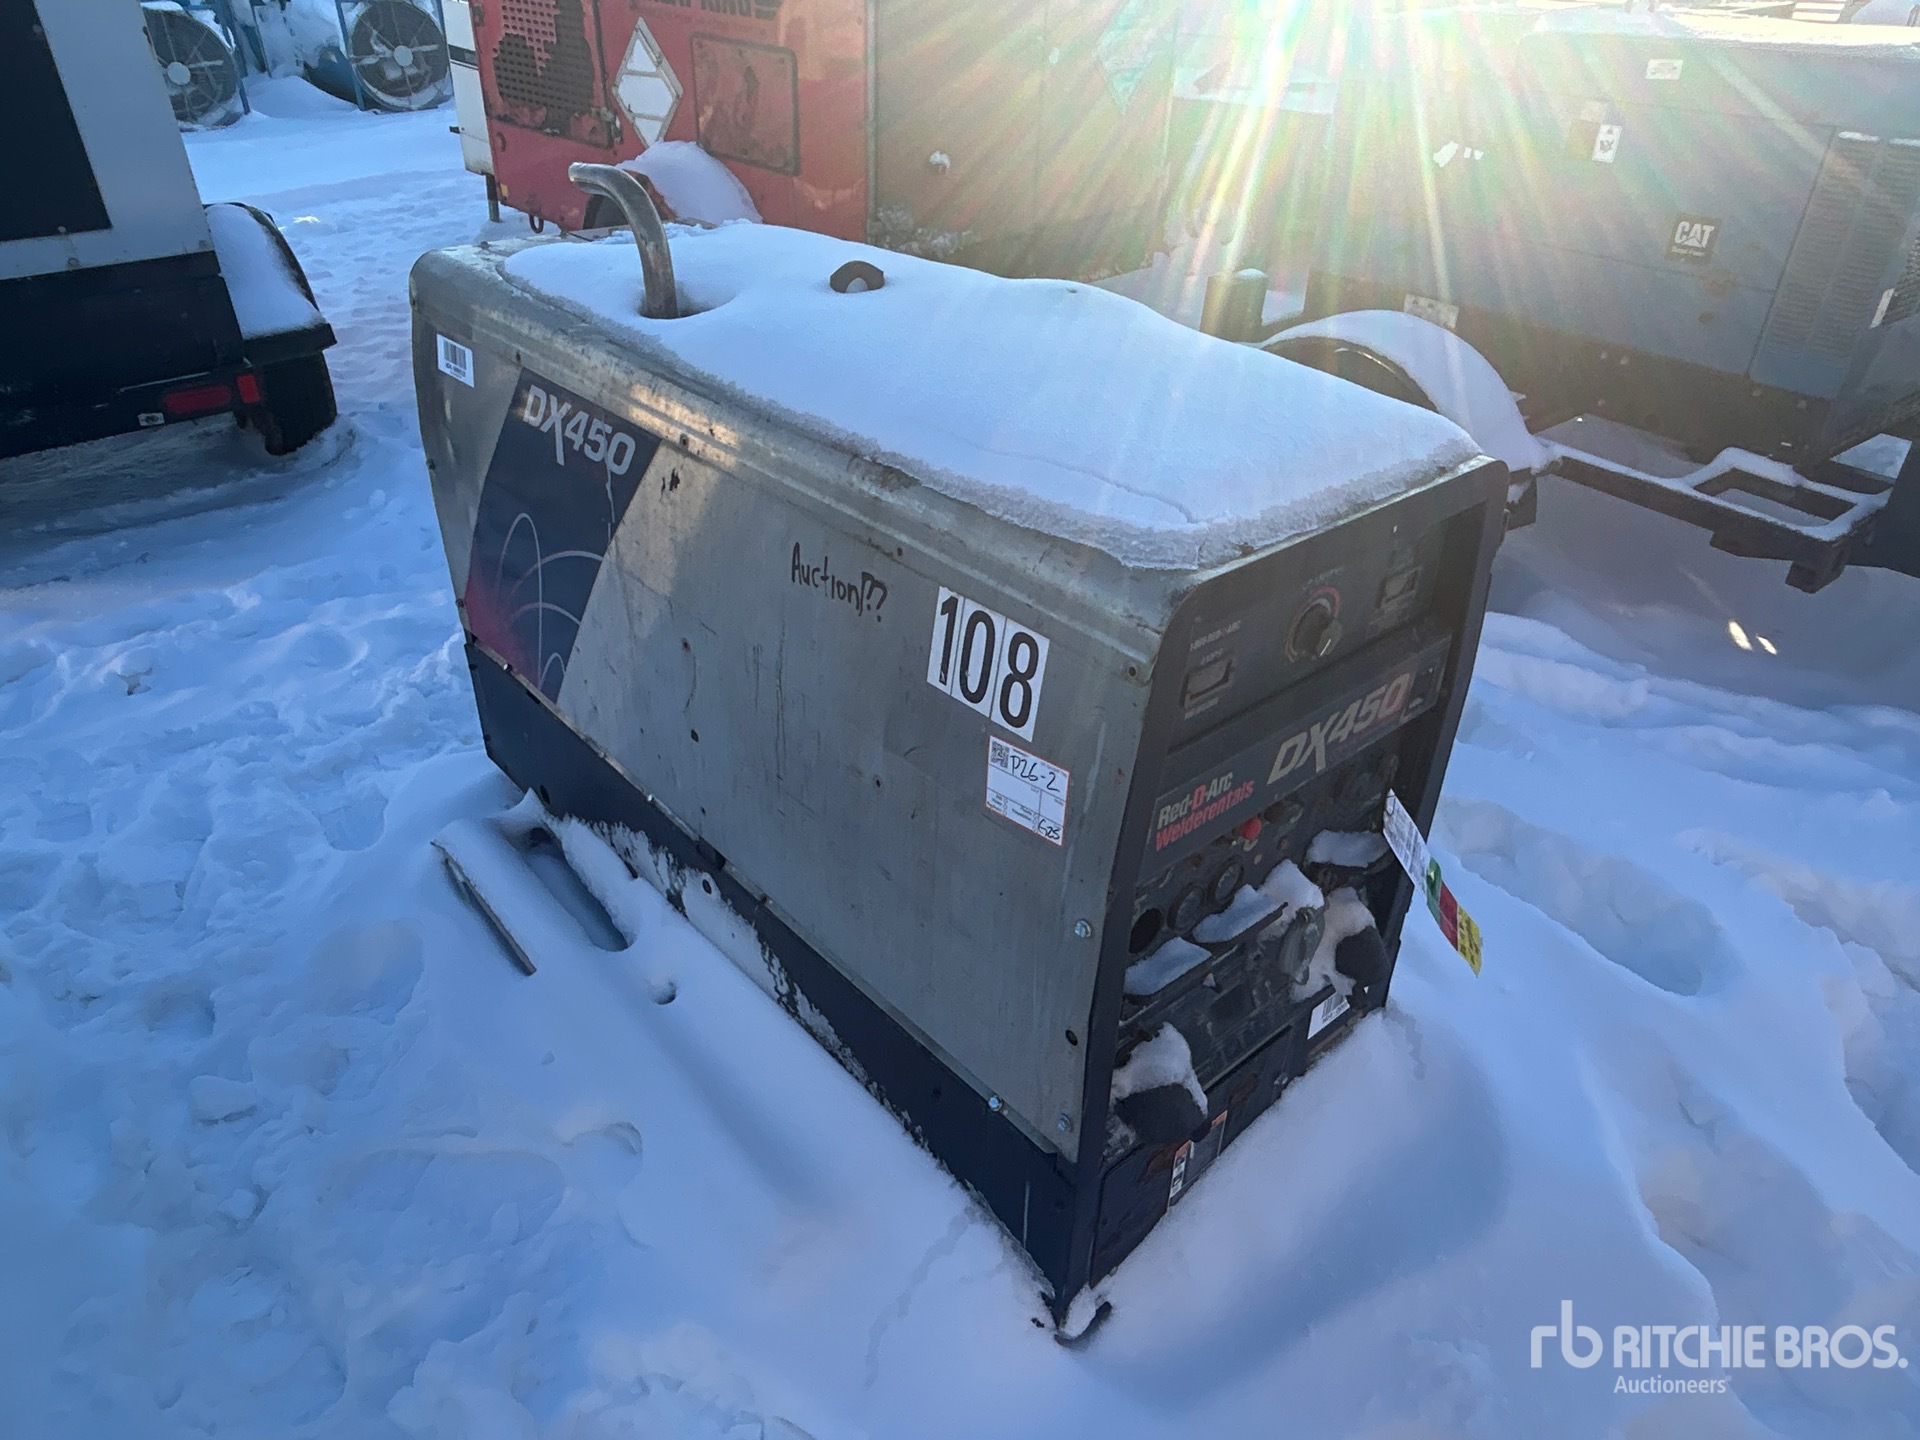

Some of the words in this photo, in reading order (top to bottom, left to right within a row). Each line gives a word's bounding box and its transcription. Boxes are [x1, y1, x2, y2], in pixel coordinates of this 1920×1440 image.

[1674, 221, 1715, 248] CAT
[522, 384, 637, 476] DX450
[939, 595, 1040, 729] 108
[1266, 672, 1411, 786] DX450
[1155, 780, 1255, 852] Welderentals
